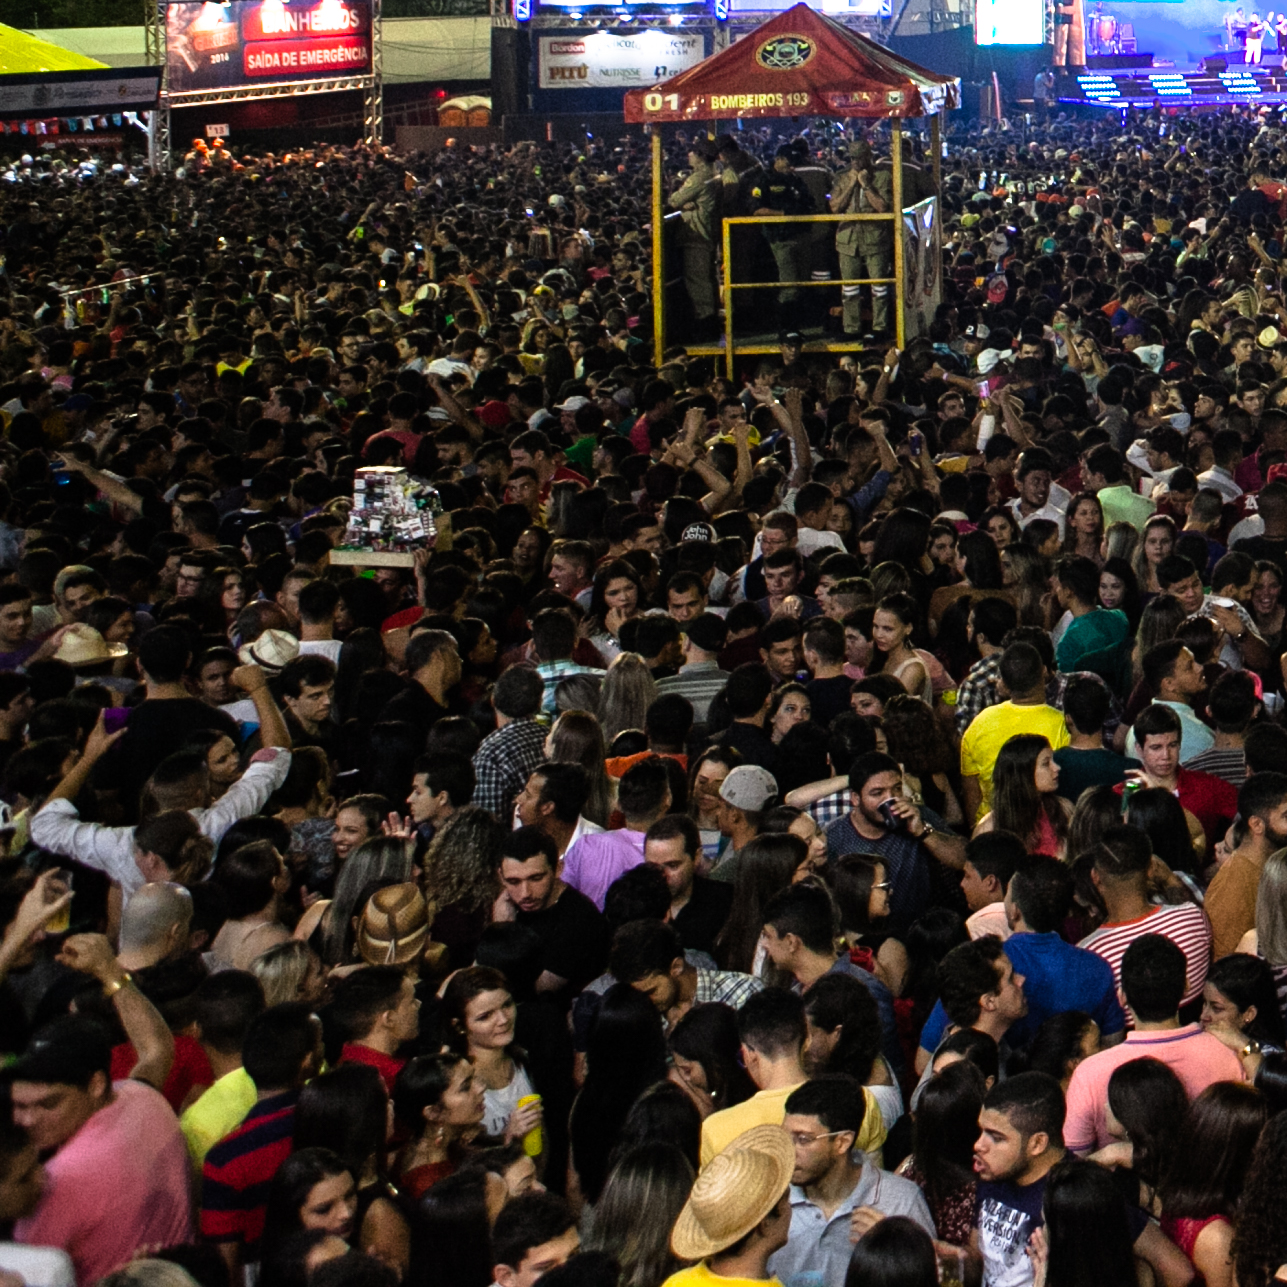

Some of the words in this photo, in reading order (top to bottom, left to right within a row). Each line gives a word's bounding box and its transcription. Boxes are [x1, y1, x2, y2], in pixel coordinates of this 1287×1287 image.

[247, 50, 280, 69] SAÍDA
[284, 52, 298, 67] DE
[299, 45, 368, 66] EMERGÊNCIA
[551, 43, 586, 54] Bordon
[644, 93, 679, 111] 01
[710, 92, 784, 110] BOMBEIROS
[786, 91, 808, 107] 193
